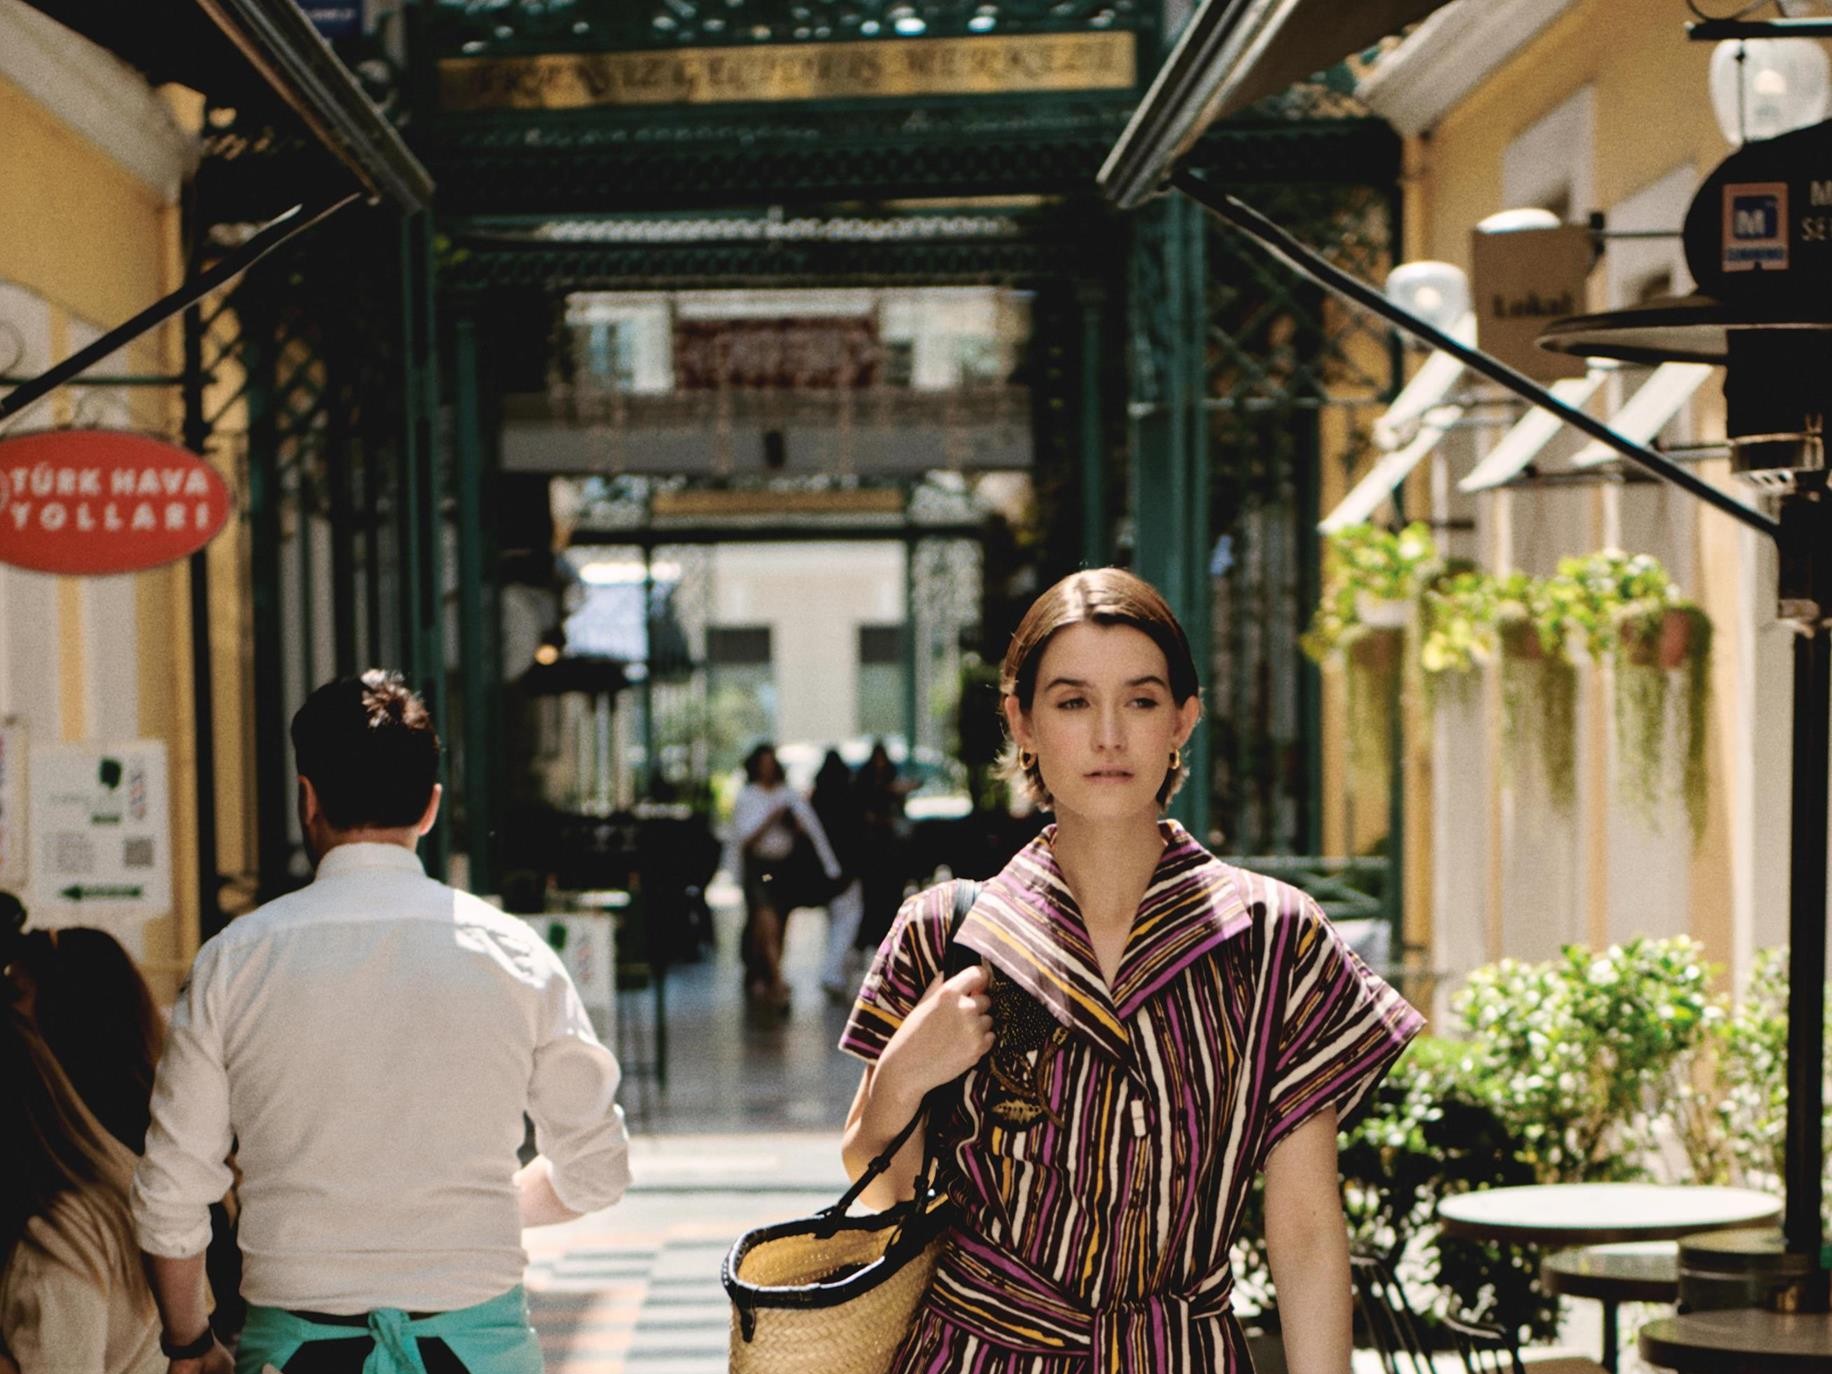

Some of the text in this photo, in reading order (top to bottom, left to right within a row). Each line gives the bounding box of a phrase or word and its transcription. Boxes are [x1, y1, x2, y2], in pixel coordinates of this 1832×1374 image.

[10, 460, 209, 497] TÜRK HAVA
[10, 501, 210, 532] YOLLARI
